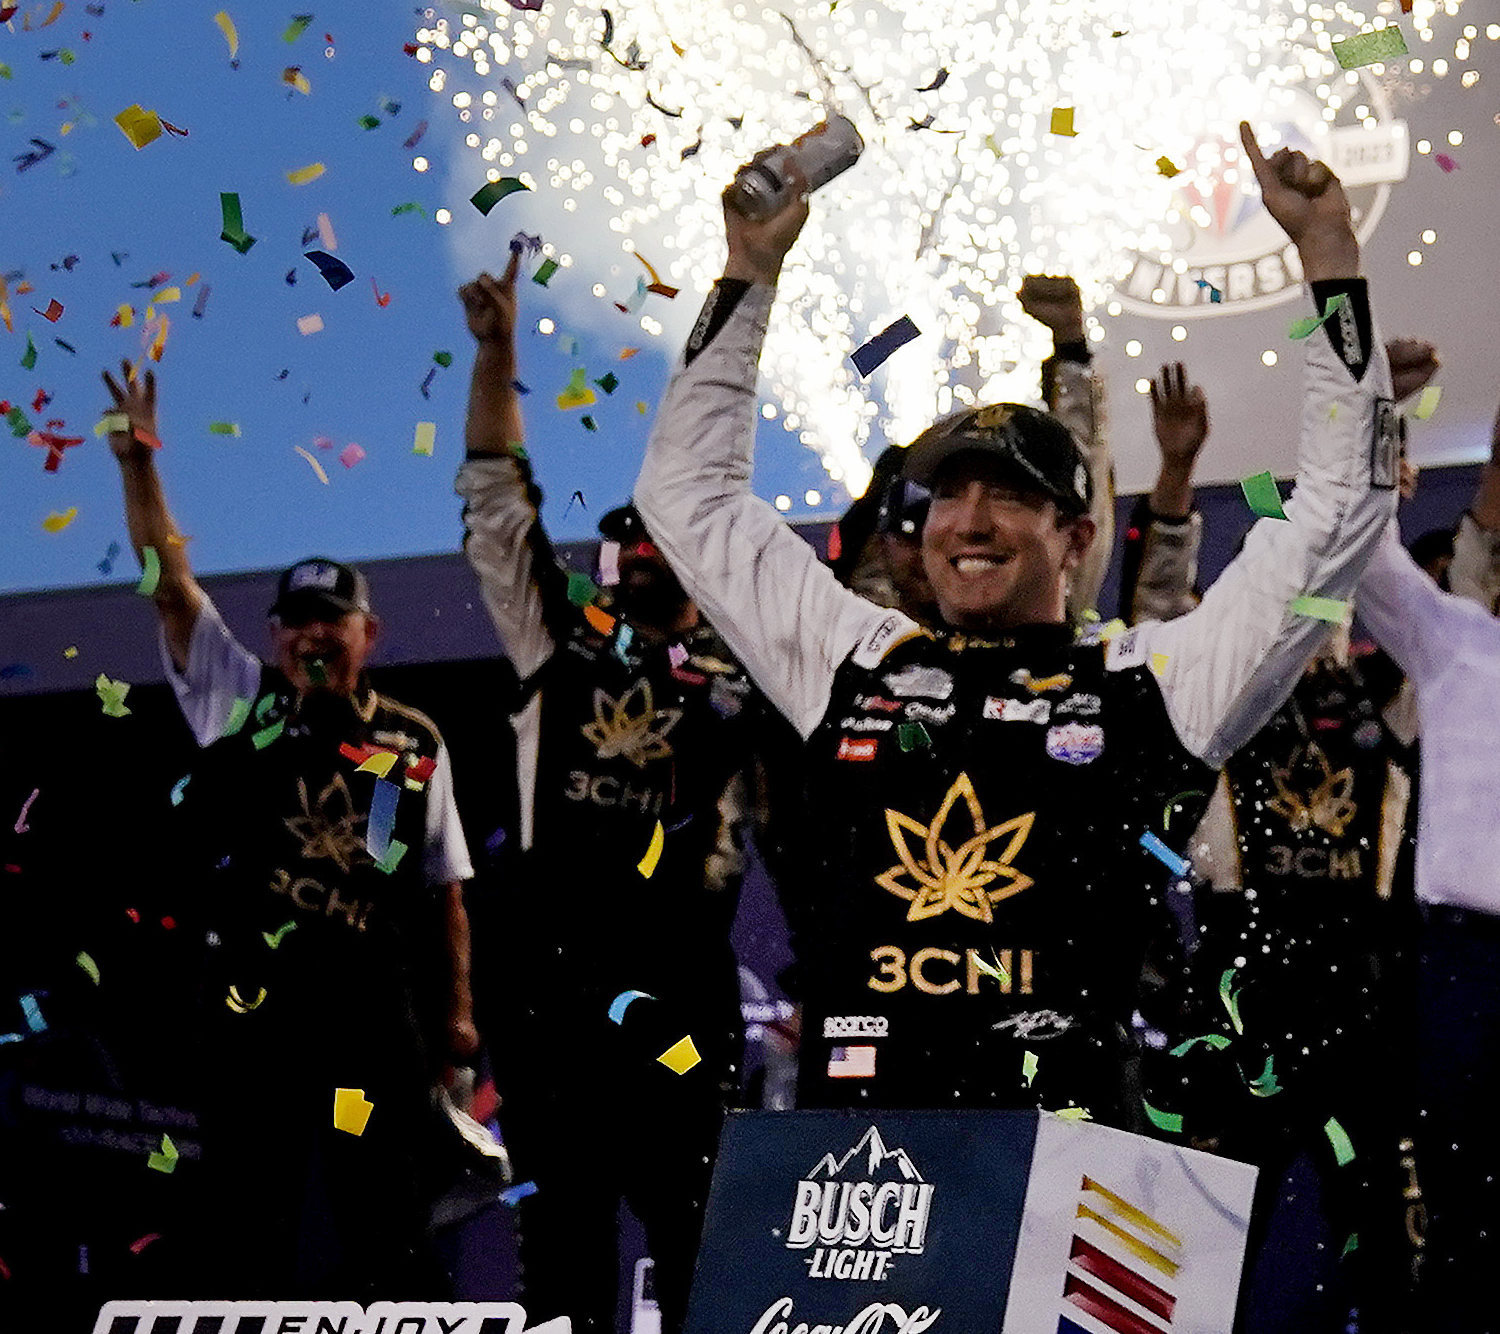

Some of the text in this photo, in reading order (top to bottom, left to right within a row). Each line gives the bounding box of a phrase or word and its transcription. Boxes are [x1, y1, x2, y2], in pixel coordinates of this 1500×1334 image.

[867, 945, 1034, 996] 3CHI
[785, 1179, 935, 1254] BUSCH
[805, 1248, 892, 1281] LIGHT
